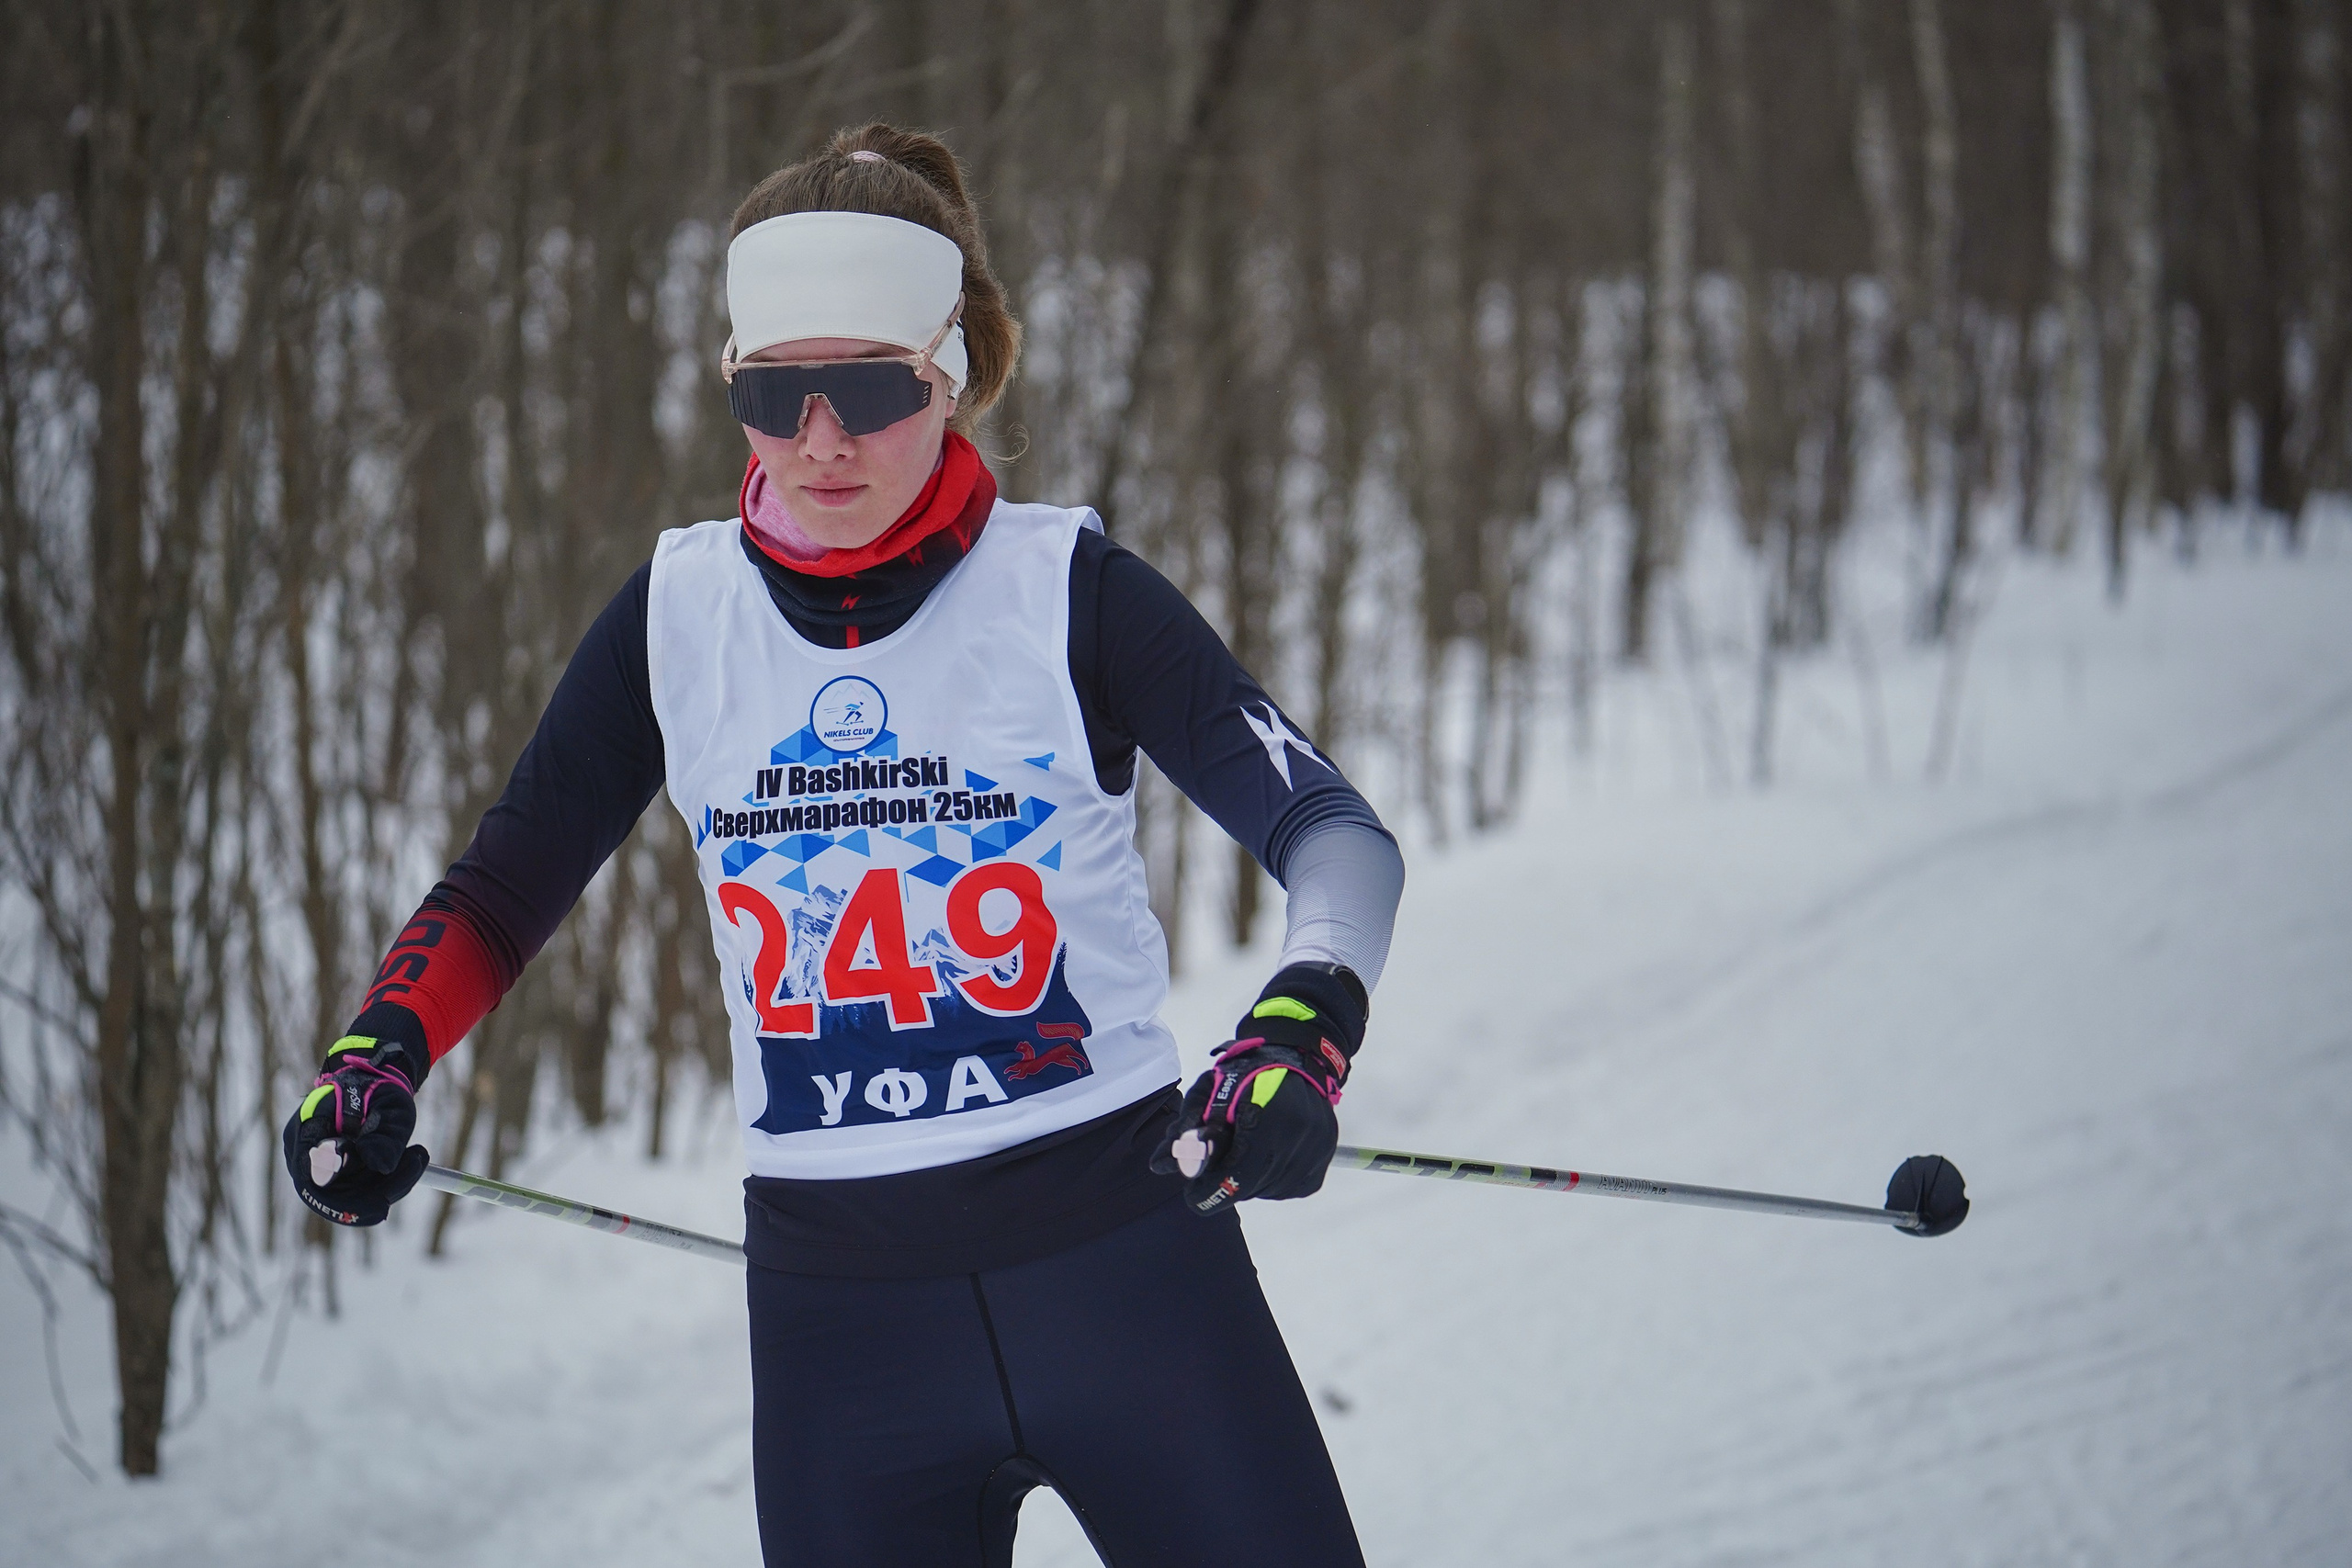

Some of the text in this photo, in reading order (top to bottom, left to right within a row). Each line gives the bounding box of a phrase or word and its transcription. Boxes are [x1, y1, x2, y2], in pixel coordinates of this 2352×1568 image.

[823, 728, 874, 739] NIKELS CLUB
[756, 756, 948, 799] IV BashkirSki
[713, 796, 927, 839] Сверхмарафон
[718, 862, 1057, 1034] 249
[810, 1055, 1009, 1125] УФА
